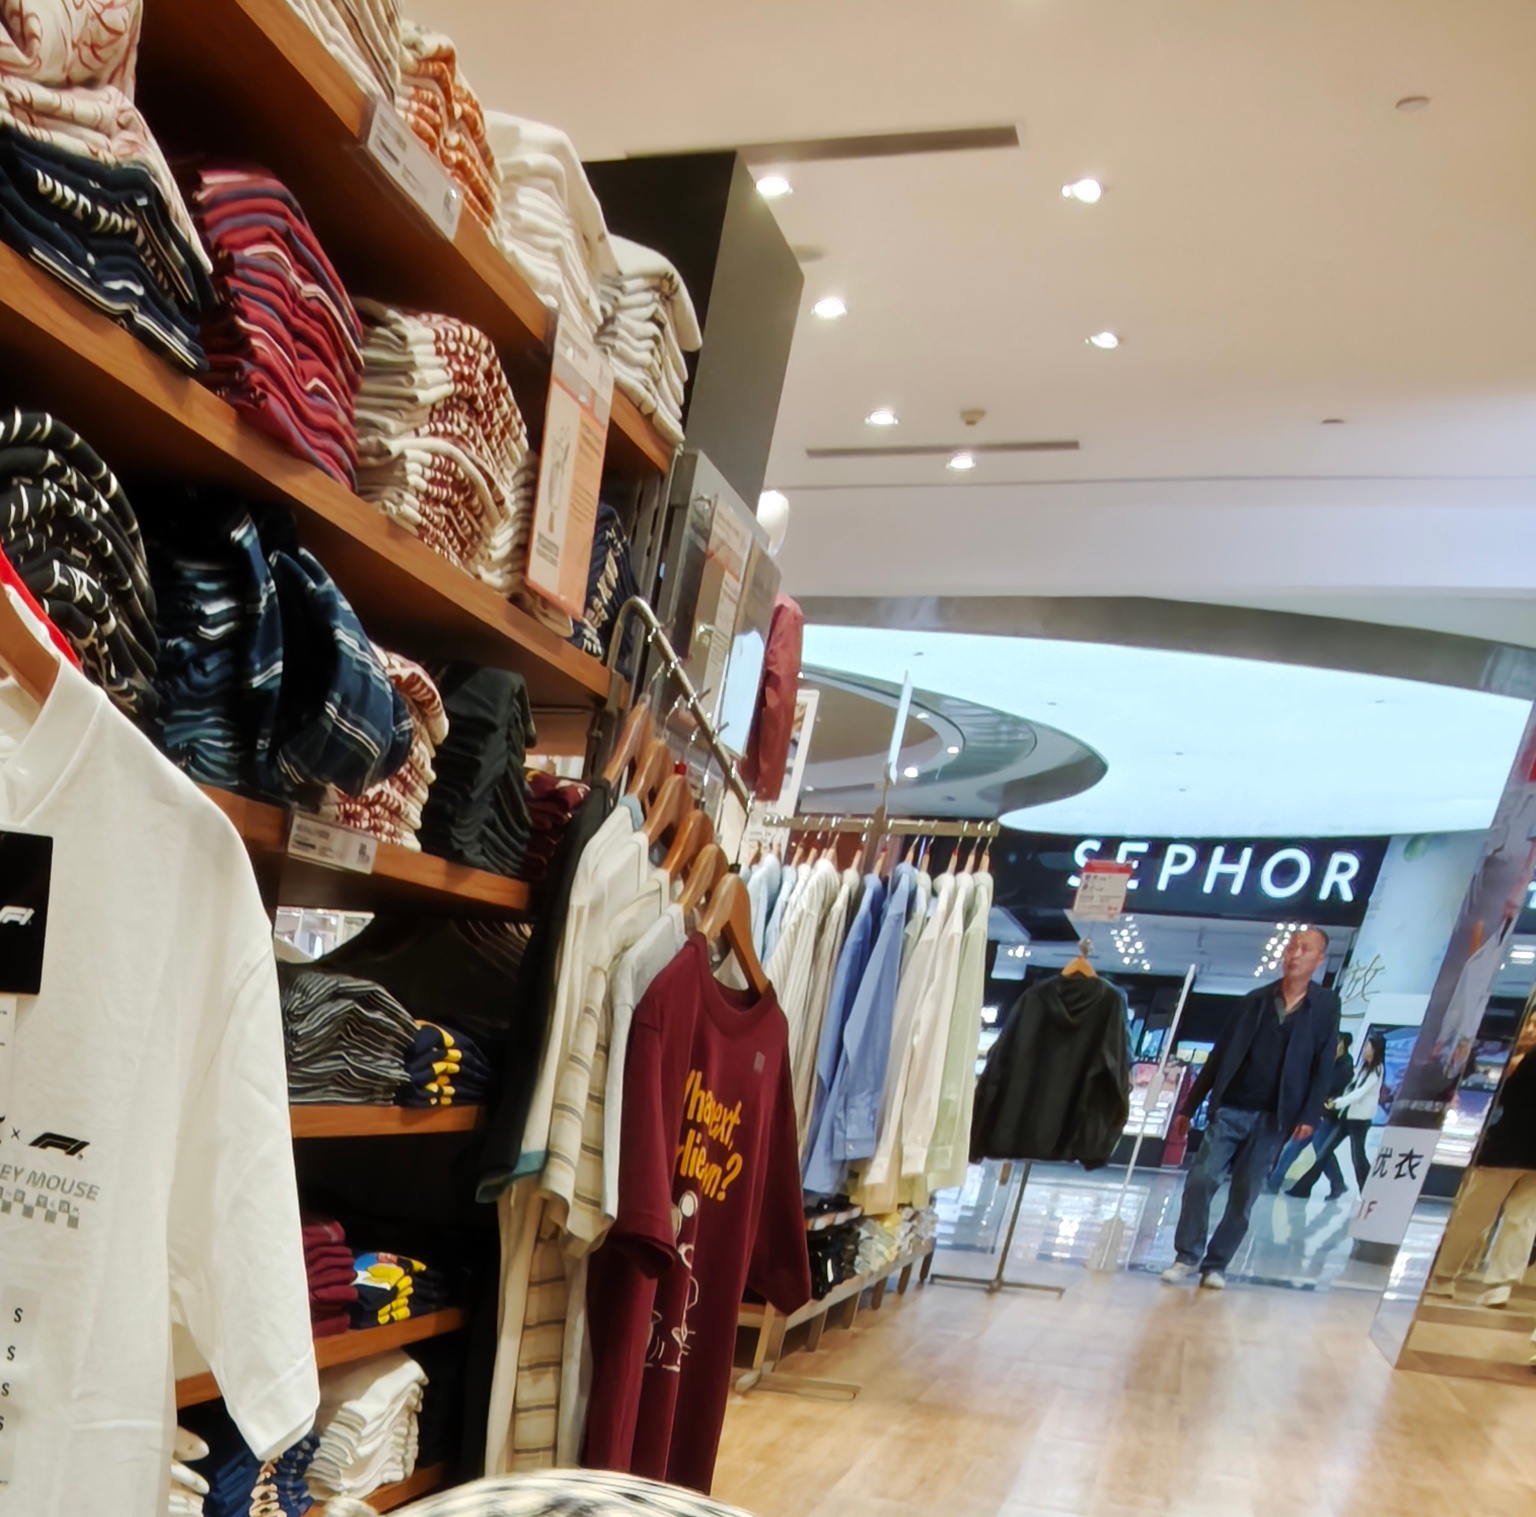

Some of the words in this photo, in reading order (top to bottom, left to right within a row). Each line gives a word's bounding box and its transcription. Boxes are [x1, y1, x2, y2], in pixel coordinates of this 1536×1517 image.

[25, 1169, 101, 1201] MOUSE
[14, 1307, 23, 1324] S
[6, 1345, 16, 1361] S
[1, 1382, 10, 1397] S
